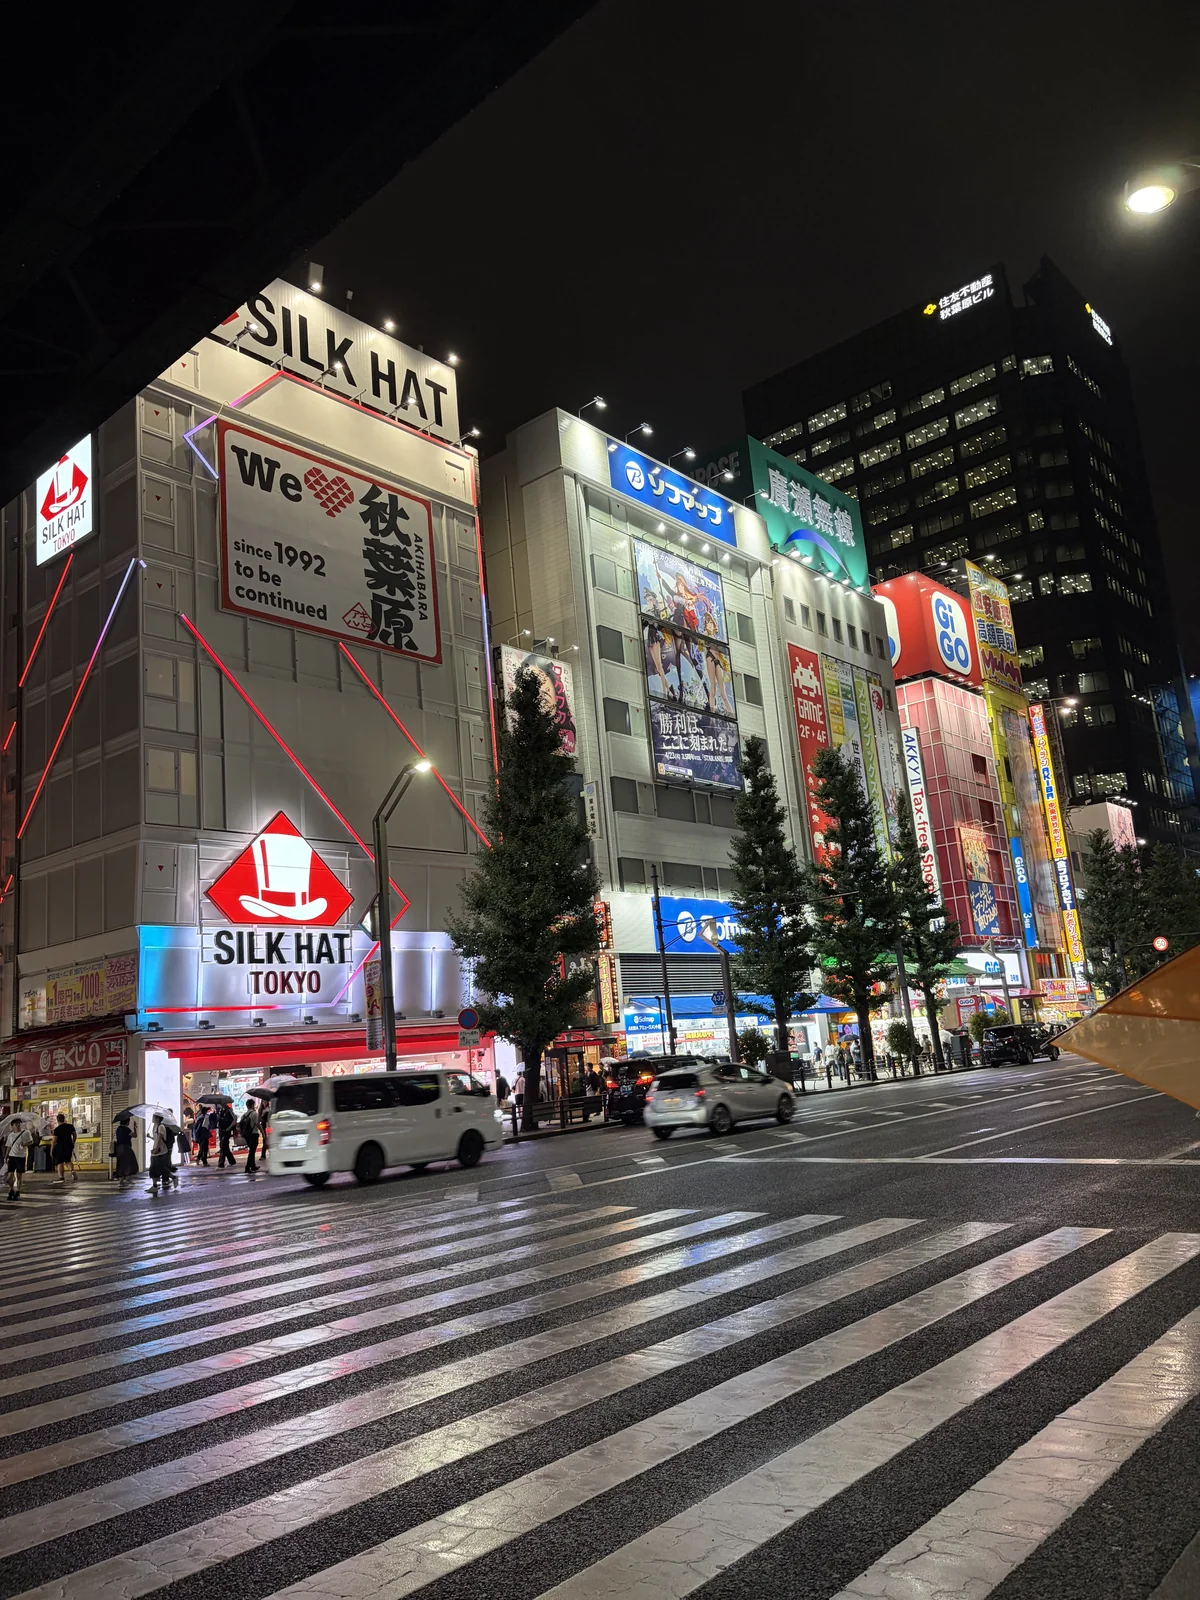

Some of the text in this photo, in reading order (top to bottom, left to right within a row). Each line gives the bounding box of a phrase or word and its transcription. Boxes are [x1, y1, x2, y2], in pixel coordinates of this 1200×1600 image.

[938, 273, 994, 309] 住友不動産
[939, 287, 995, 321] 秋葉原ビル
[246, 294, 448, 428] SILK HAT
[231, 445, 303, 502] We
[648, 473, 722, 526] ソフマップ
[42, 500, 87, 545] SILK HAT
[53, 528, 76, 553] TOKYO
[234, 539, 327, 578] since 1992
[234, 560, 282, 587] to be
[359, 483, 419, 652] 秋葉原
[414, 532, 428, 621] AKIHABARA
[235, 585, 328, 622] continued
[660, 711, 704, 735] 勝利は、
[797, 697, 824, 725] GAME
[662, 735, 733, 753] ここに刻まれた。
[799, 724, 827, 744] 2F 4F
[856, 687, 878, 795] メロンブックス
[903, 733, 921, 774] AKKY
[1041, 767, 1055, 800] AKIBA
[912, 788, 931, 853] Tax-free
[921, 853, 936, 894] Shop
[1014, 856, 1027, 884] GiGO
[214, 930, 350, 965] SILK HAT
[599, 941, 607, 949] 1F
[1156, 939, 1166, 948] 50
[79, 971, 101, 1001] 7000
[249, 970, 321, 995] TOKYO
[712, 994, 725, 1002] 437
[53, 1044, 86, 1071] 宝くじ
